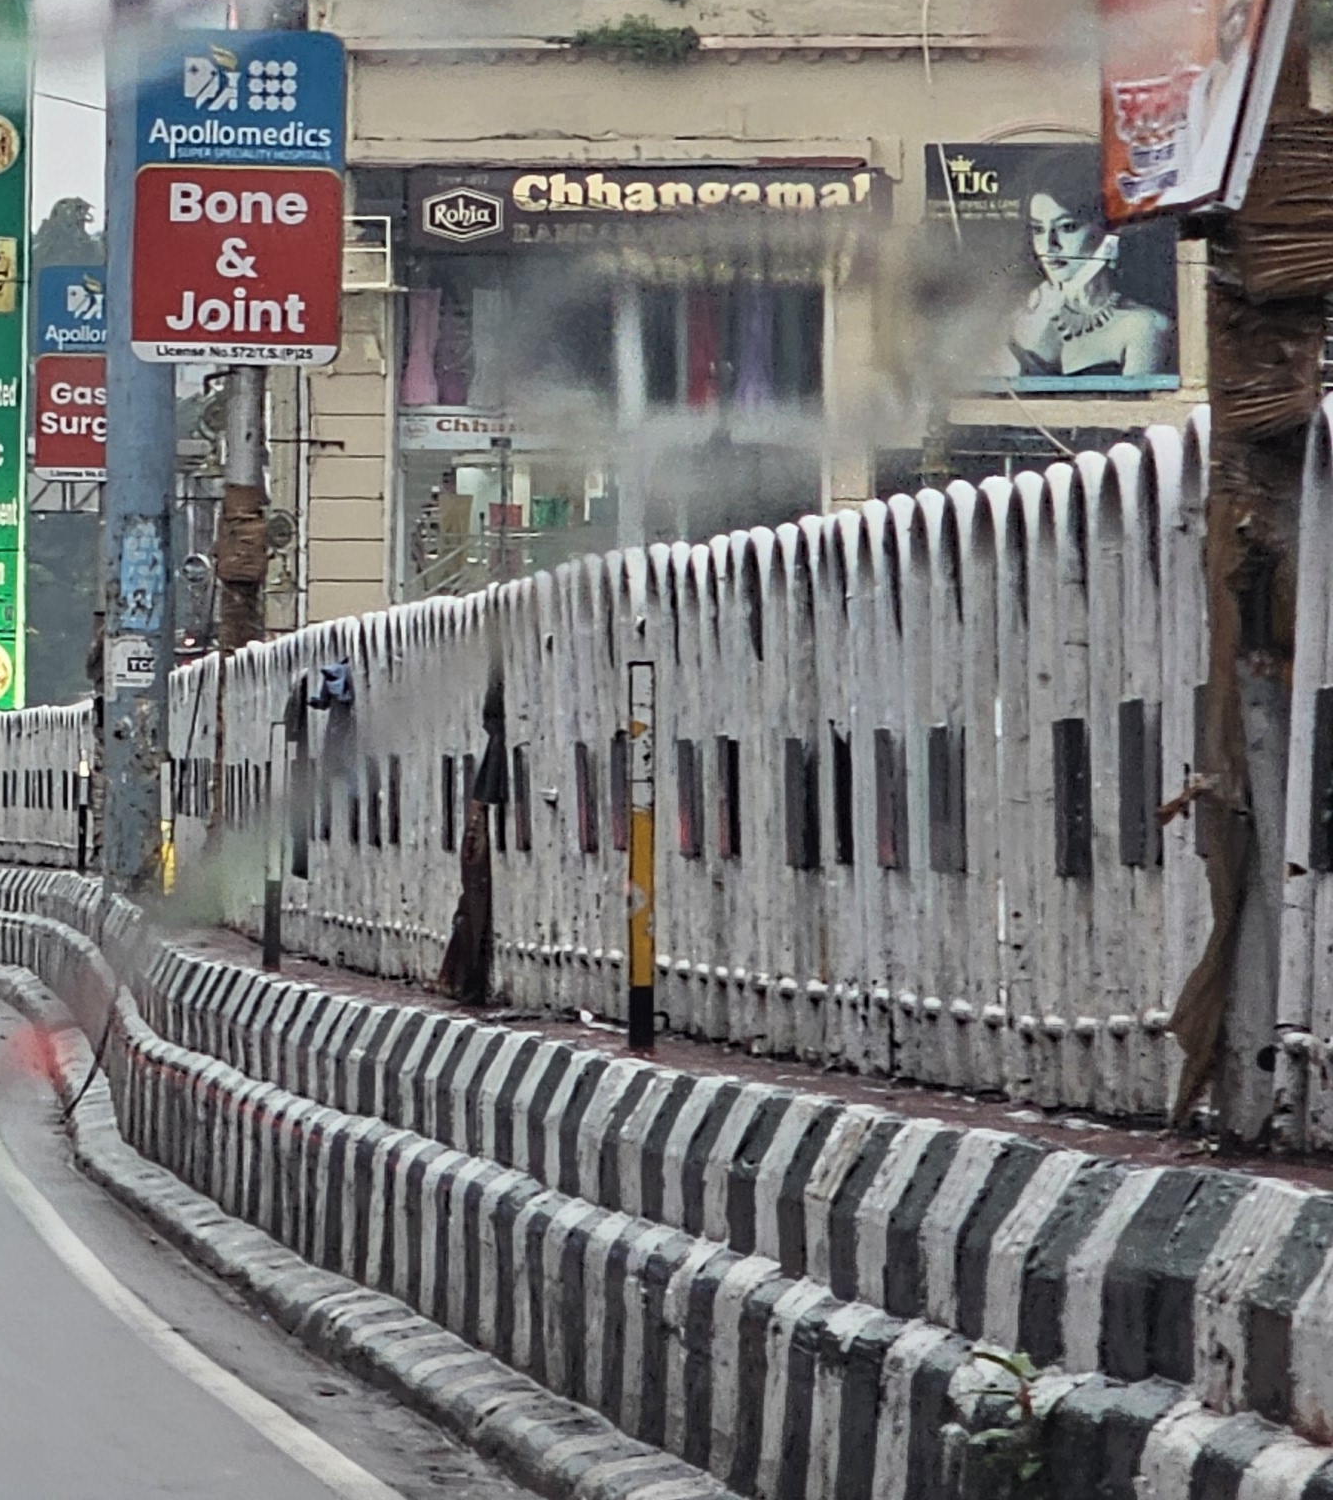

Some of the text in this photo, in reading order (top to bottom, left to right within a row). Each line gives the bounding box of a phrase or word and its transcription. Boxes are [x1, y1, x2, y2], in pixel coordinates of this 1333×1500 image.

[148, 117, 332, 160] Apollomedics
[169, 182, 308, 225] Bone
[215, 239, 257, 278] &
[165, 287, 306, 333] Joint
[45, 325, 107, 351] Apollo
